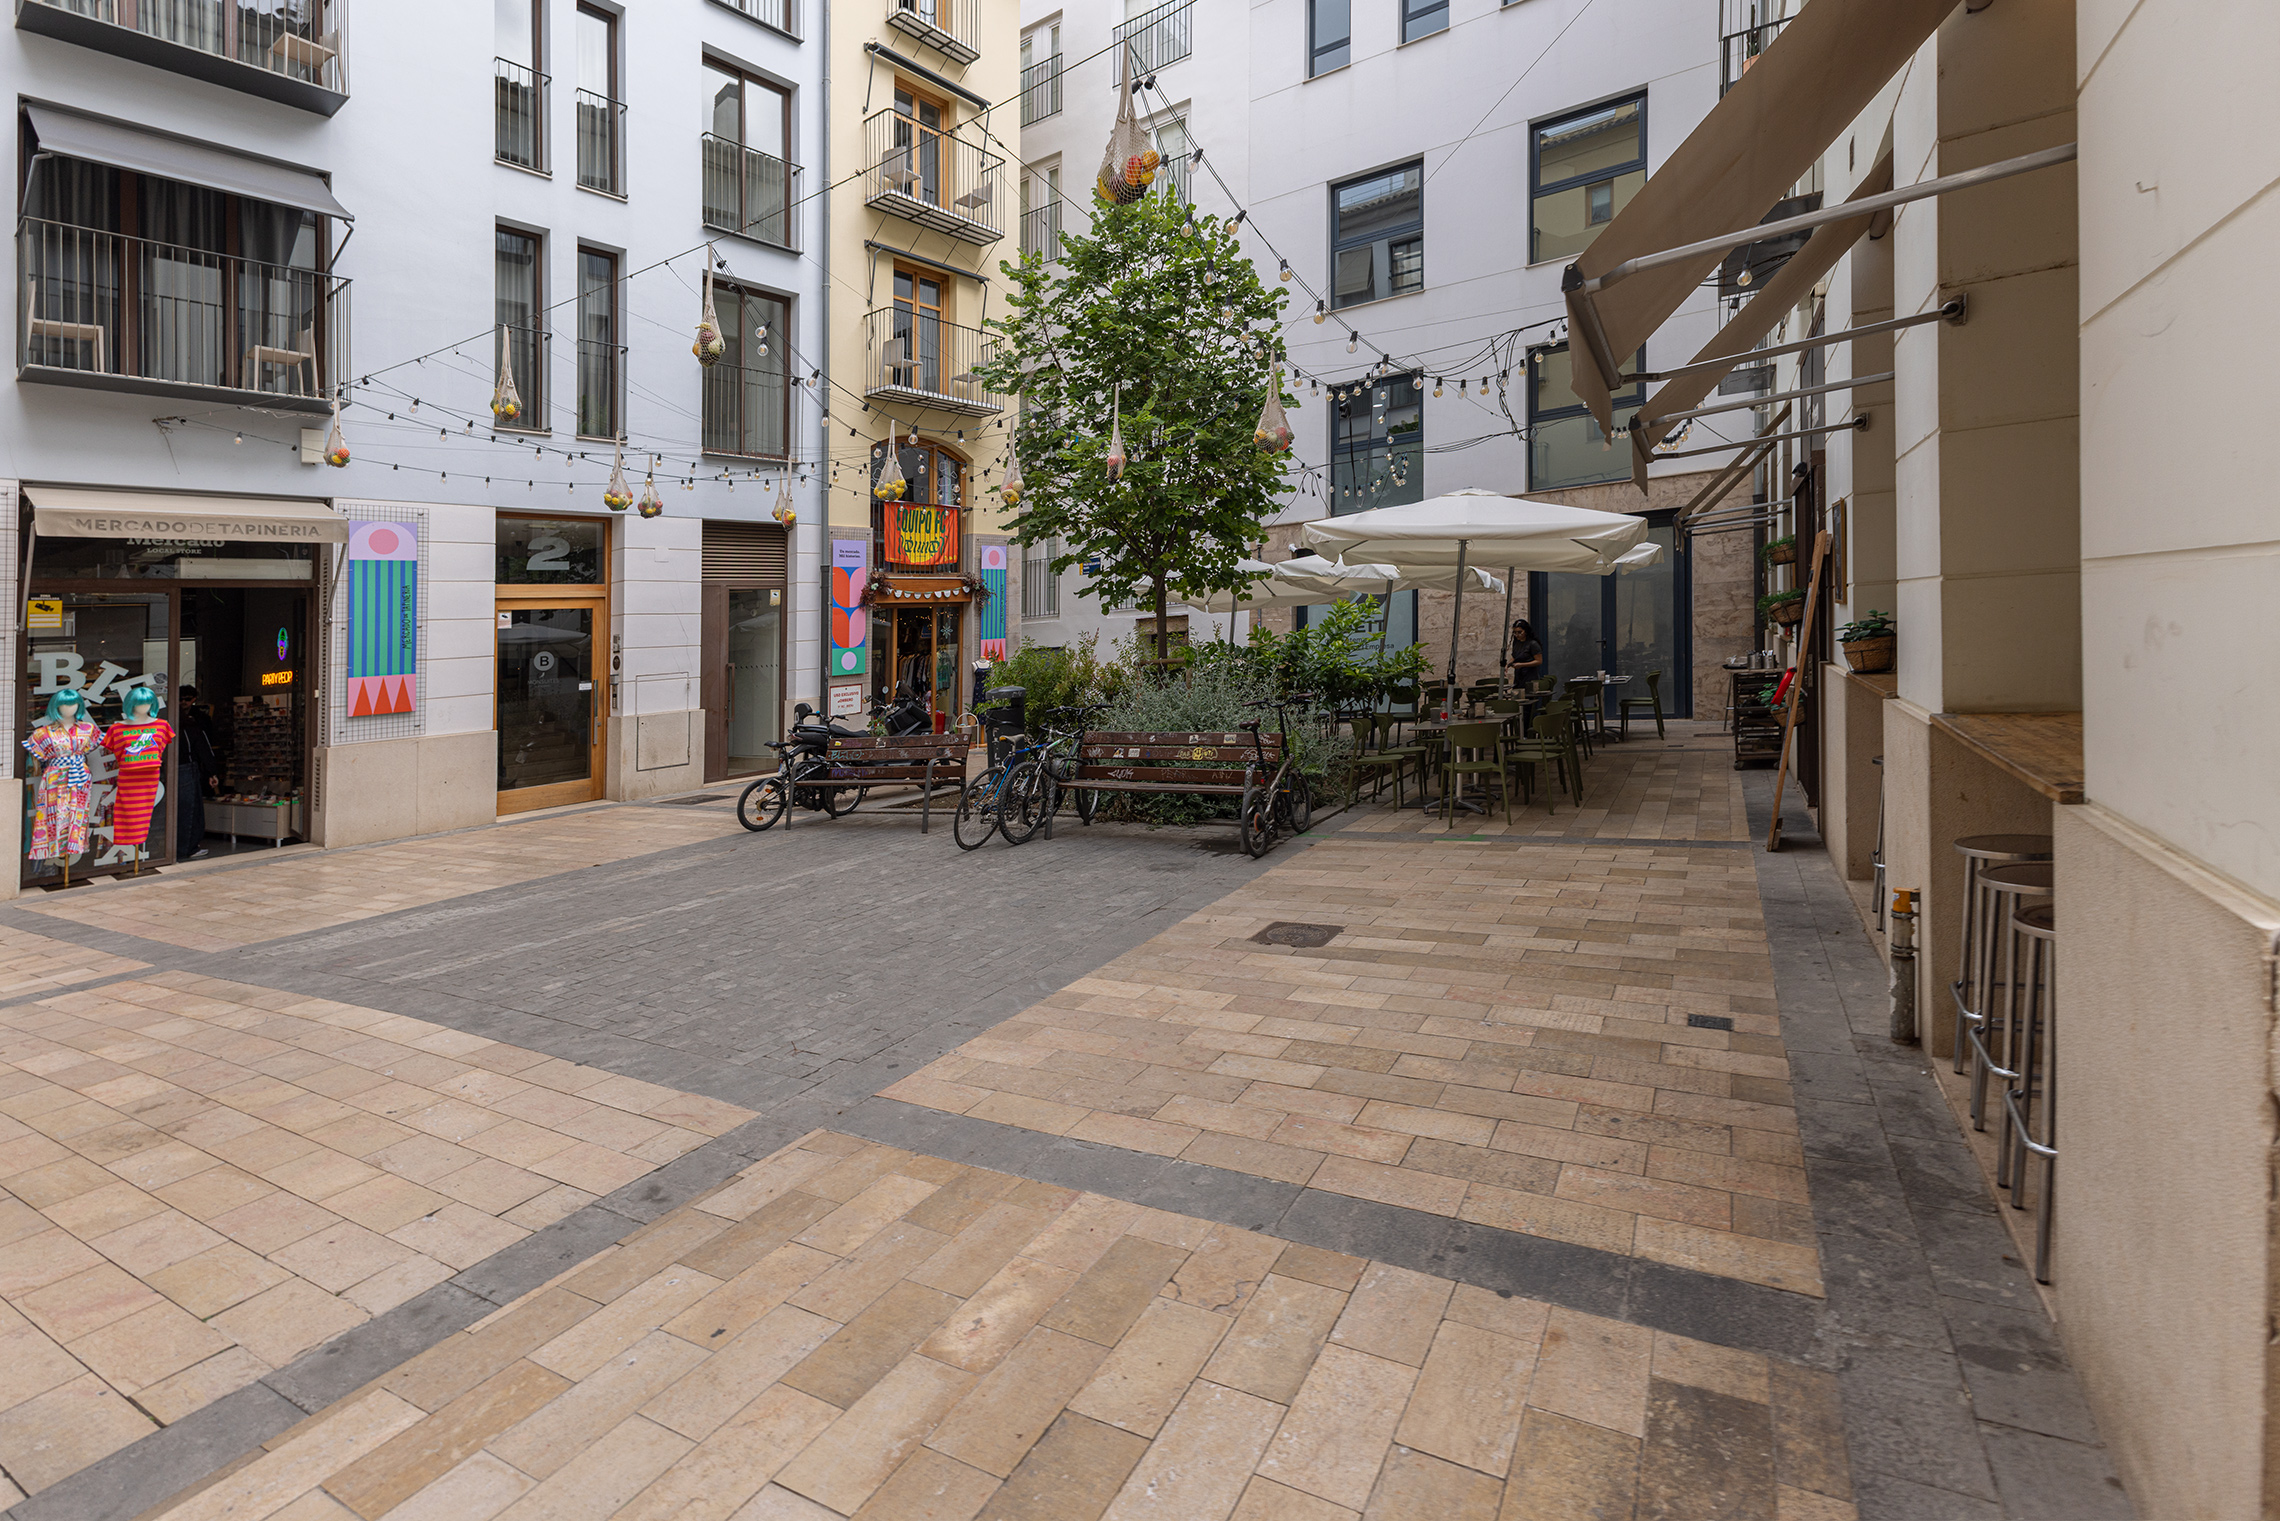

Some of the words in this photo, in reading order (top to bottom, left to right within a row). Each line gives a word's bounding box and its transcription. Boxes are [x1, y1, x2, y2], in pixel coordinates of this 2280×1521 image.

[897, 507, 932, 534] EQUIPO
[75, 518, 187, 533] MERCADO
[190, 522, 216, 535] DE
[218, 522, 321, 537] TAPINERIA
[526, 536, 571, 571] 2
[540, 655, 550, 667] B
[123, 728, 157, 736] DOLCE
[131, 739, 151, 747] FAR
[124, 753, 158, 763] NIENTE
